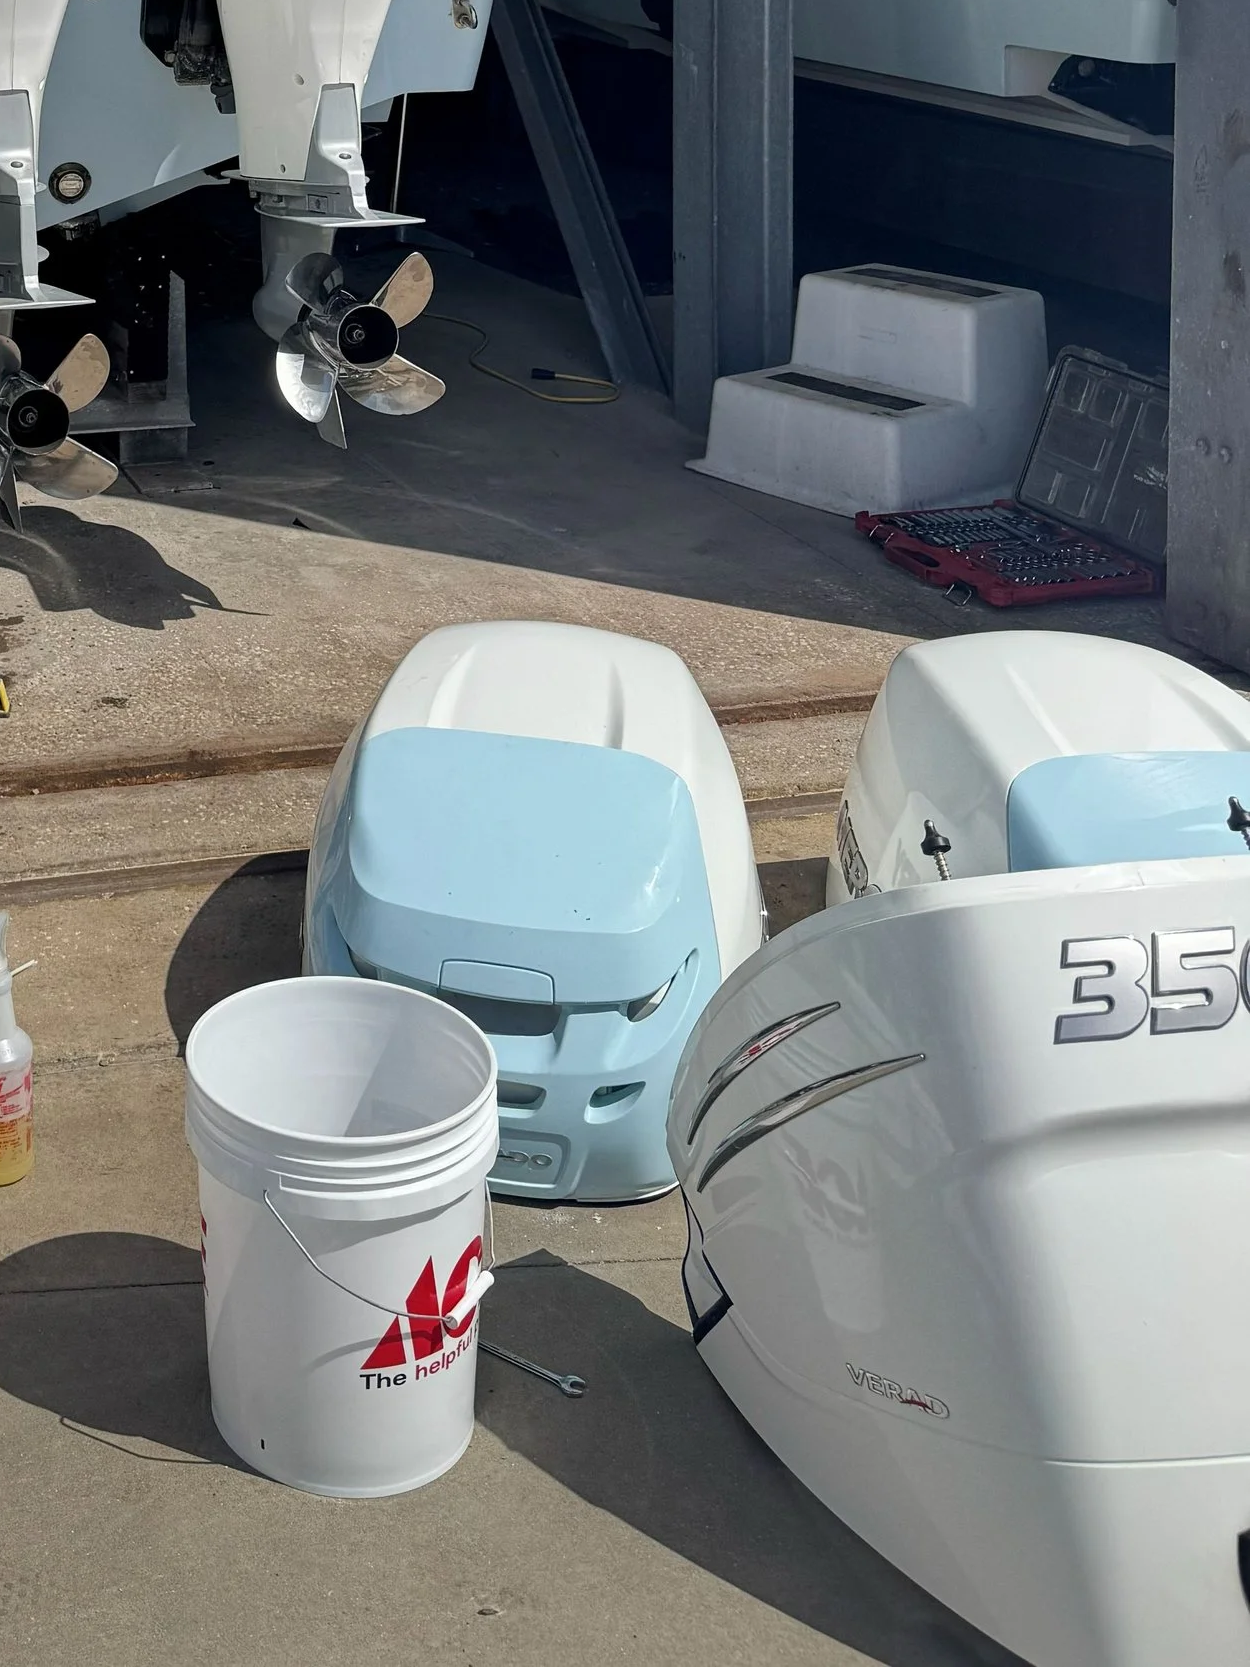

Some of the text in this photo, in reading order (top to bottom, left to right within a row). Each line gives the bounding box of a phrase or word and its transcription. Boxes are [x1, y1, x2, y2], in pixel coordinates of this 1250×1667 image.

[1053, 925, 1250, 1045] 35
[359, 1372, 407, 1390] The
[415, 1326, 473, 1381] helpful
